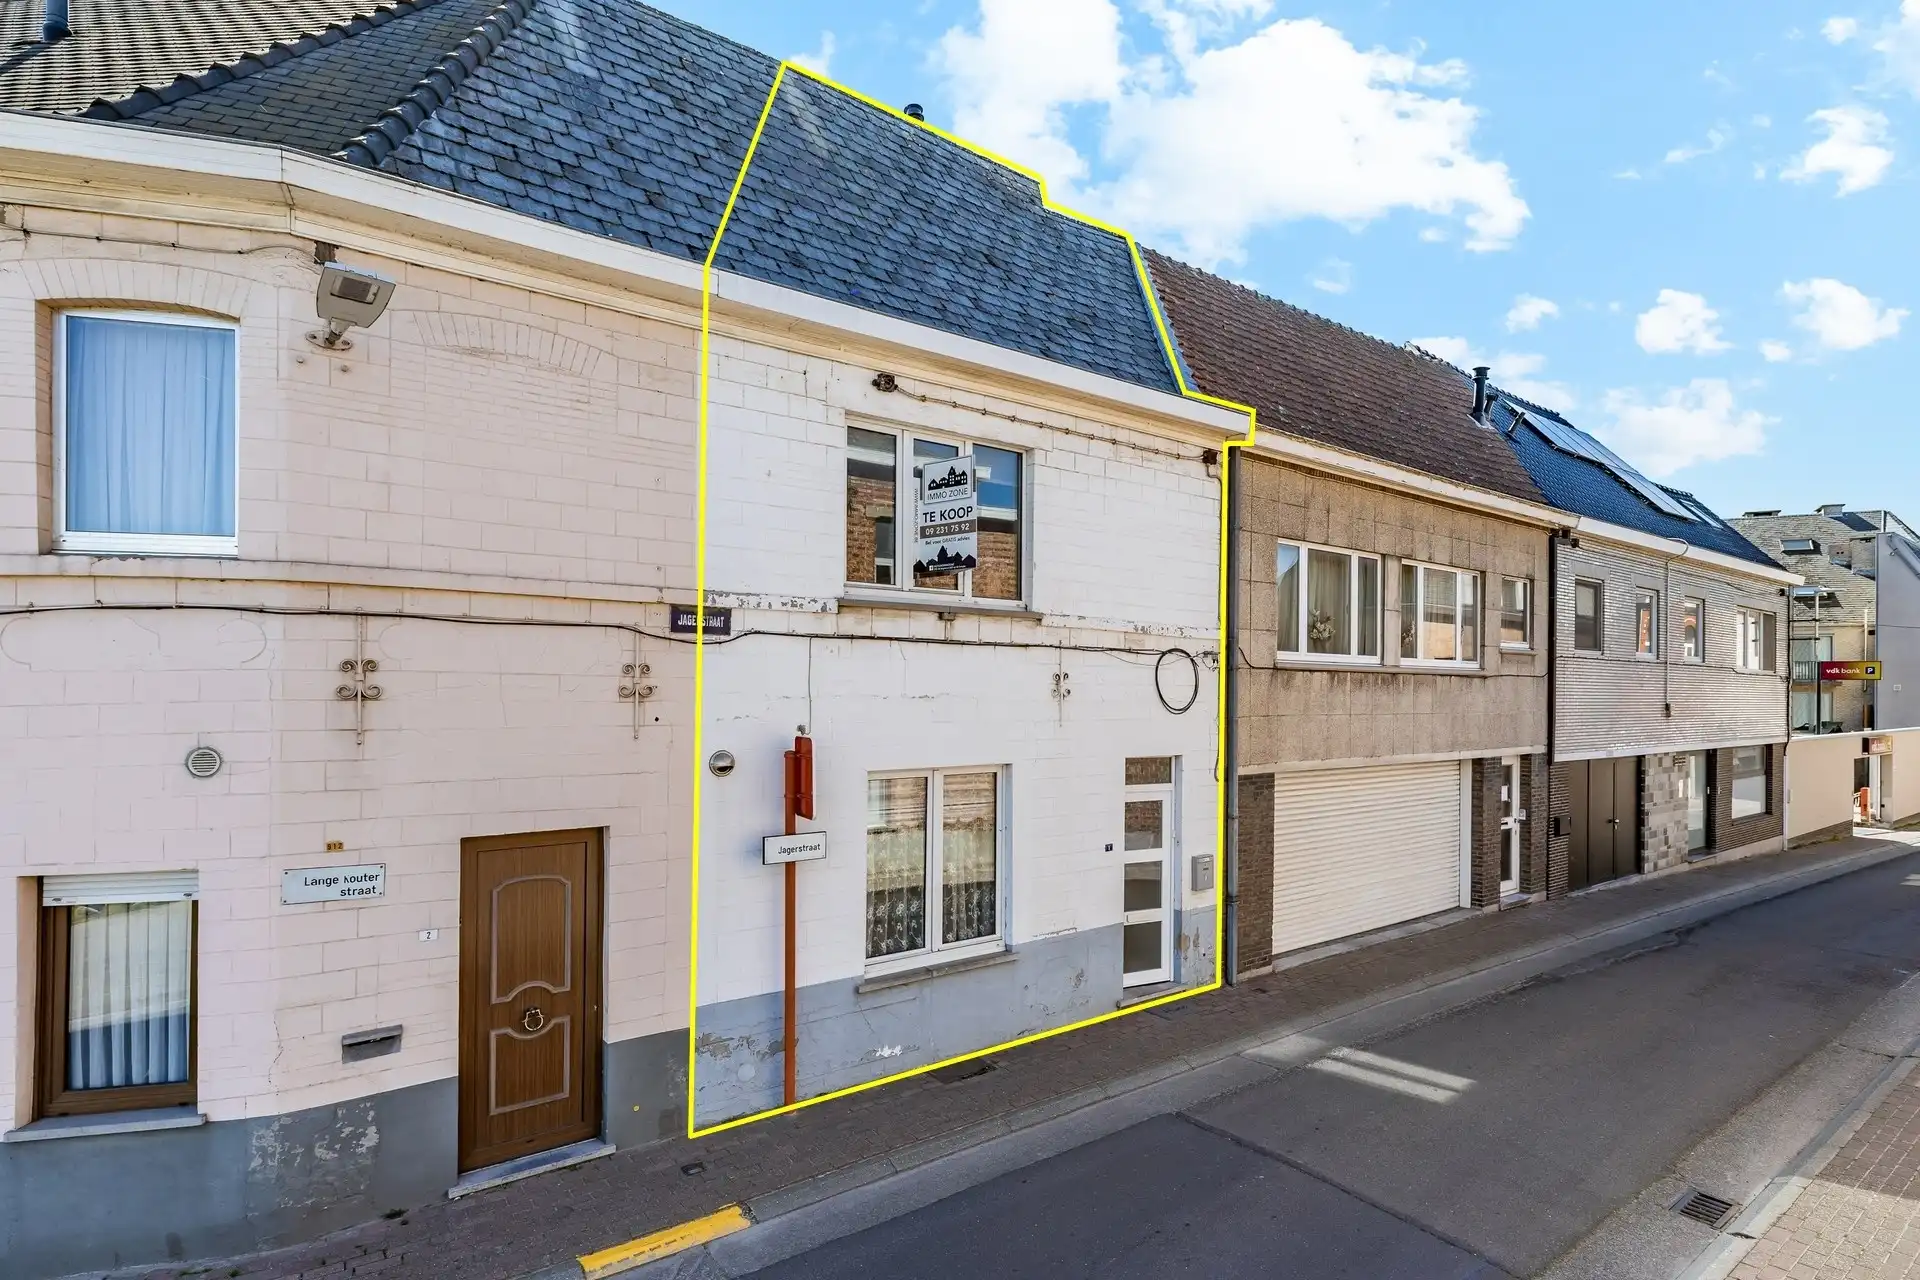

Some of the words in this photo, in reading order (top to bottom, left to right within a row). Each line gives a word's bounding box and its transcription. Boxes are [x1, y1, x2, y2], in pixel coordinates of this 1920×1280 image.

[928, 491, 947, 500] IMMO
[949, 488, 968, 497] ZONE
[923, 512, 936, 523] TE
[940, 506, 973, 521] KOOP
[961, 523, 970, 531] 92
[677, 614, 725, 627] JAGESTRAAT
[778, 844, 821, 855] Jagerstraat
[304, 876, 339, 888] Lange
[340, 885, 377, 896] straat
[426, 931, 431, 940] 2
